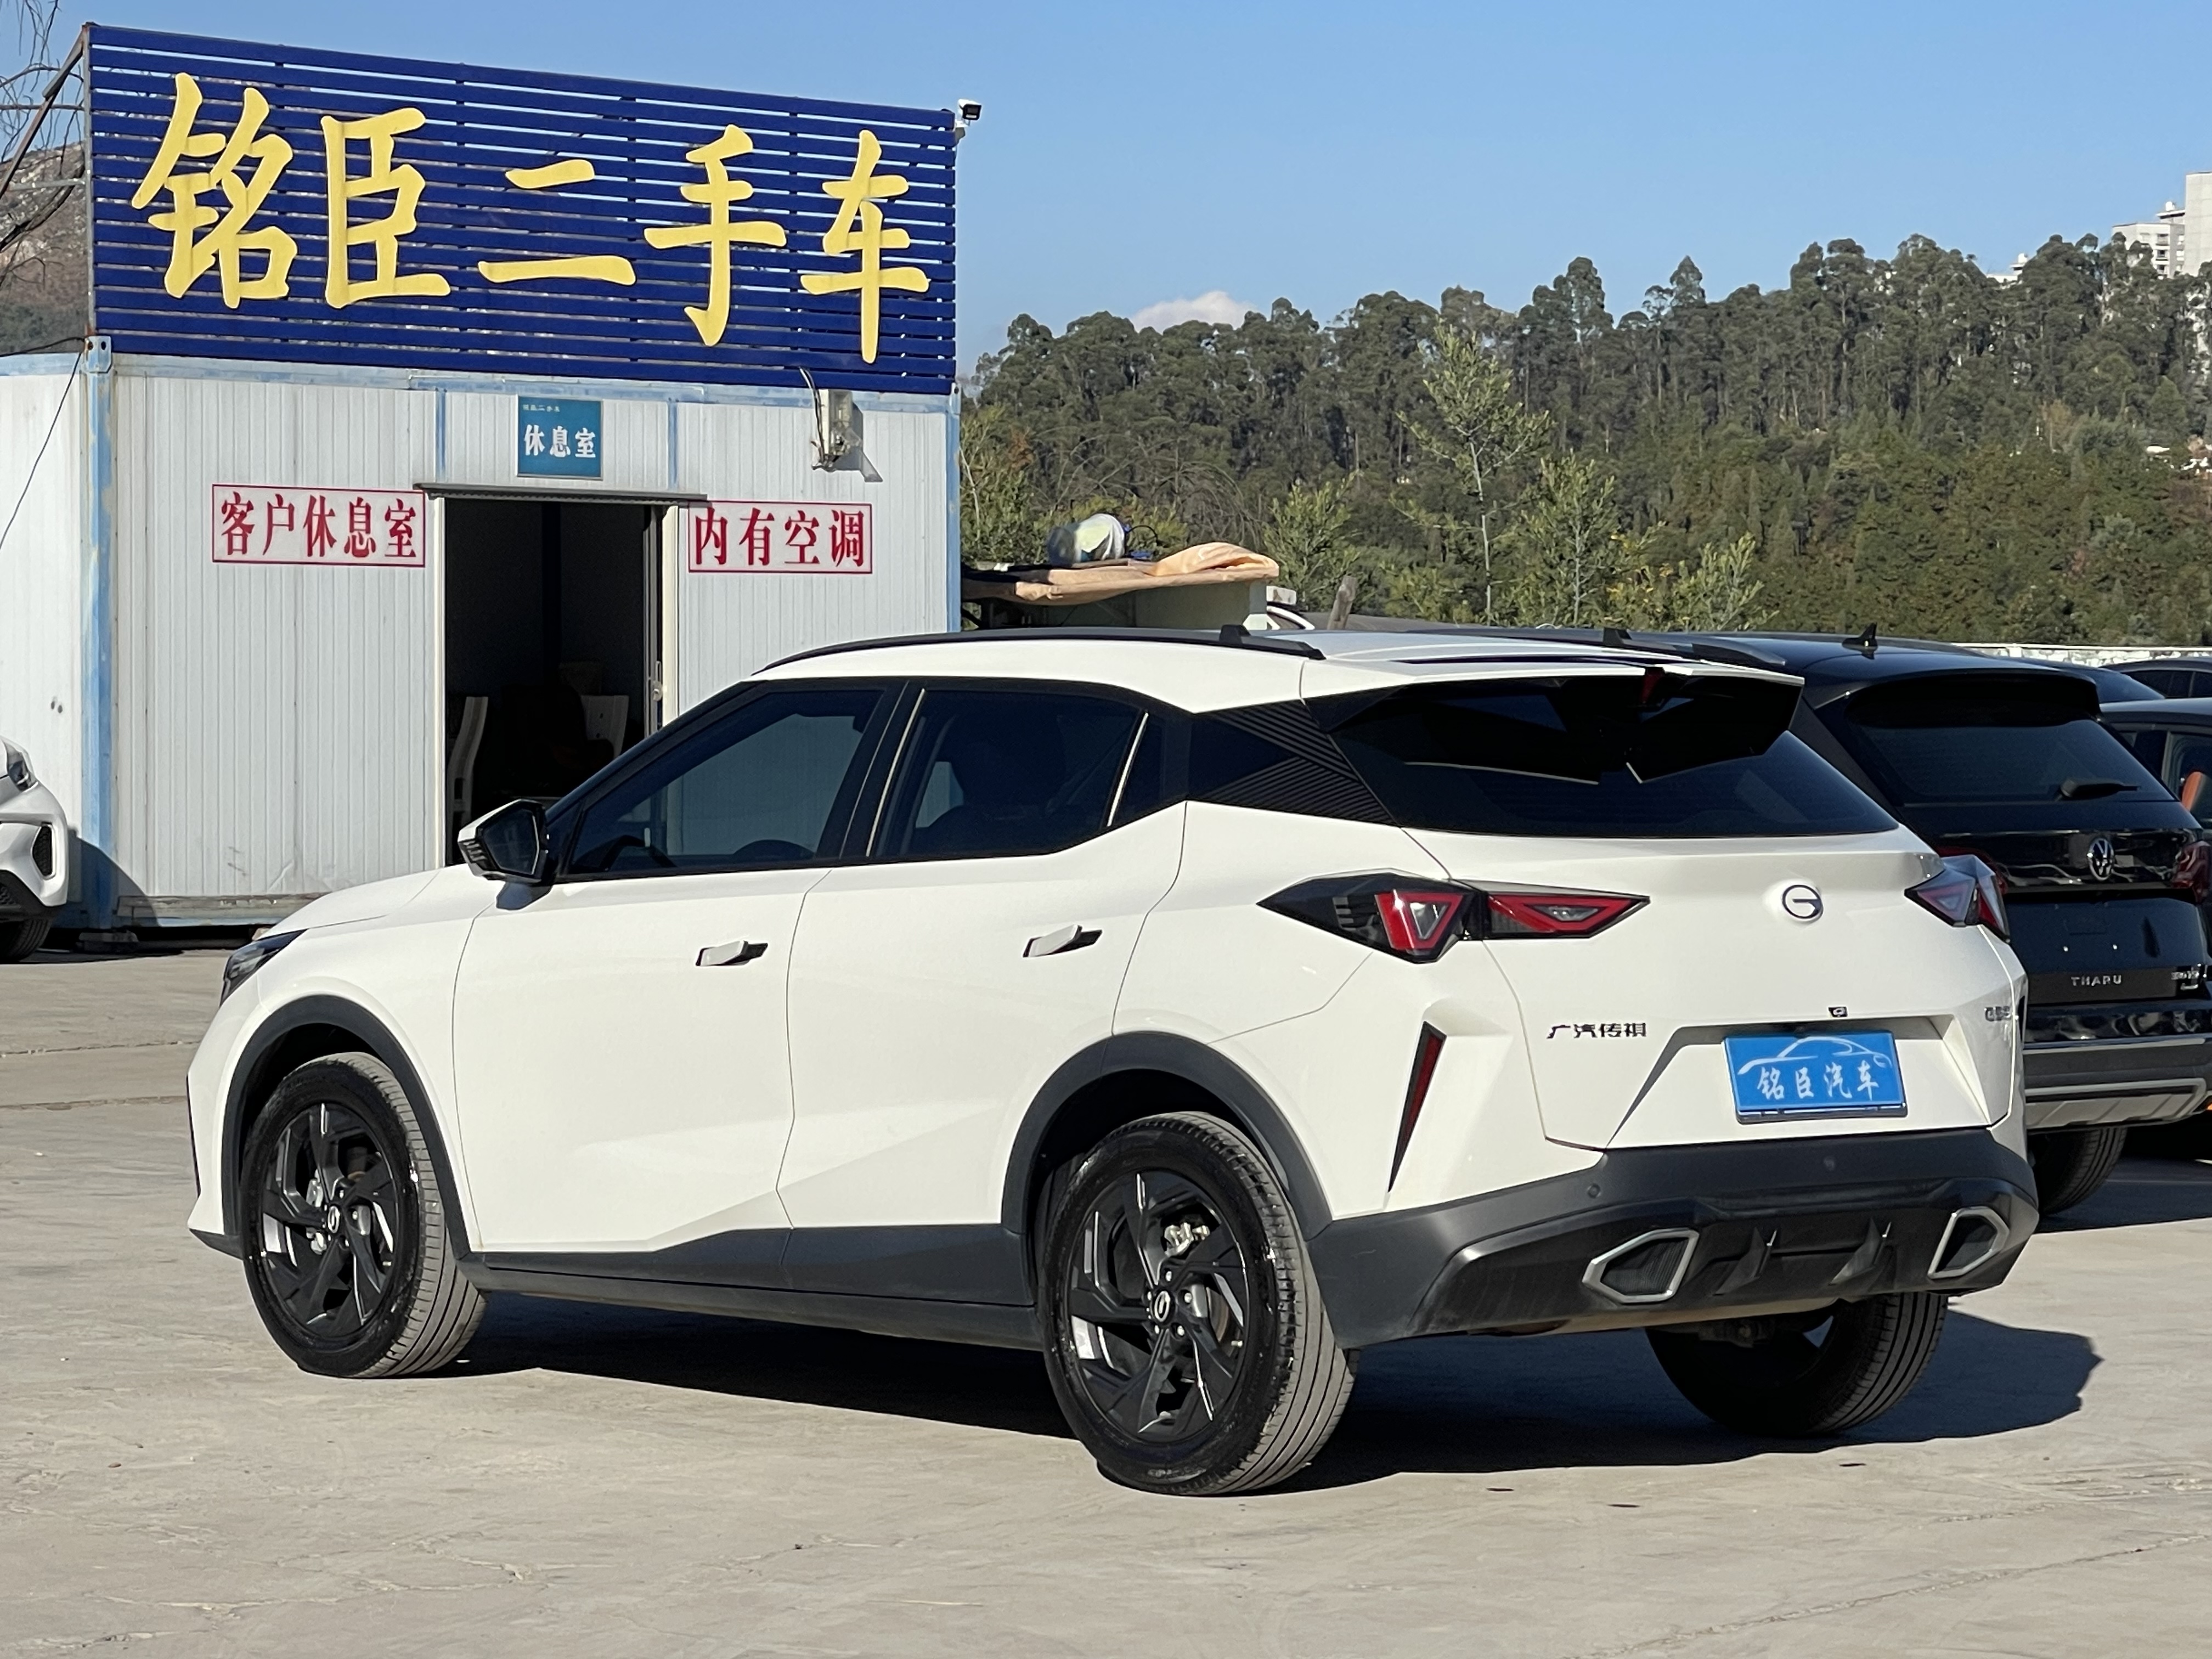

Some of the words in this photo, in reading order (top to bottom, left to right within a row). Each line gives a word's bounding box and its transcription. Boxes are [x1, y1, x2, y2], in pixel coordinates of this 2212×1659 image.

[132, 72, 928, 364] 铭臣二手车
[524, 424, 596, 458] 休息室
[221, 492, 417, 559] 客户休息室
[695, 507, 865, 567] 内有空调
[2070, 974, 2122, 986] THARU
[1757, 1060, 1880, 1101] 铭臣汽车
